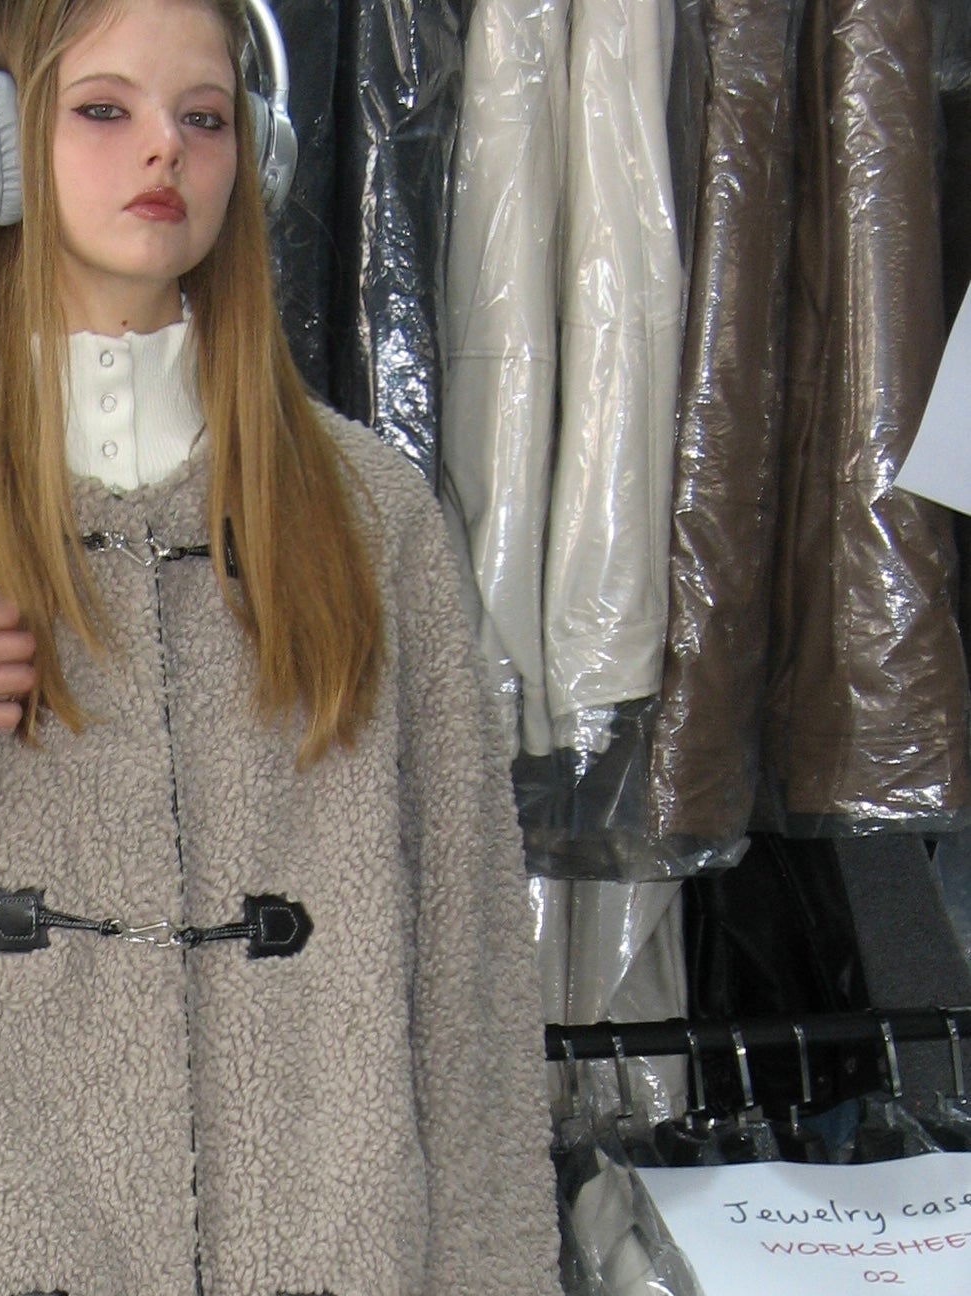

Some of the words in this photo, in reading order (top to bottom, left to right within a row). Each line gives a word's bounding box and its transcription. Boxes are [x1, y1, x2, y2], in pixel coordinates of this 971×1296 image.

[724, 1199, 886, 1235] Jewelry
[761, 1231, 971, 1257] WORKSHEE
[863, 1269, 906, 1284] 02
